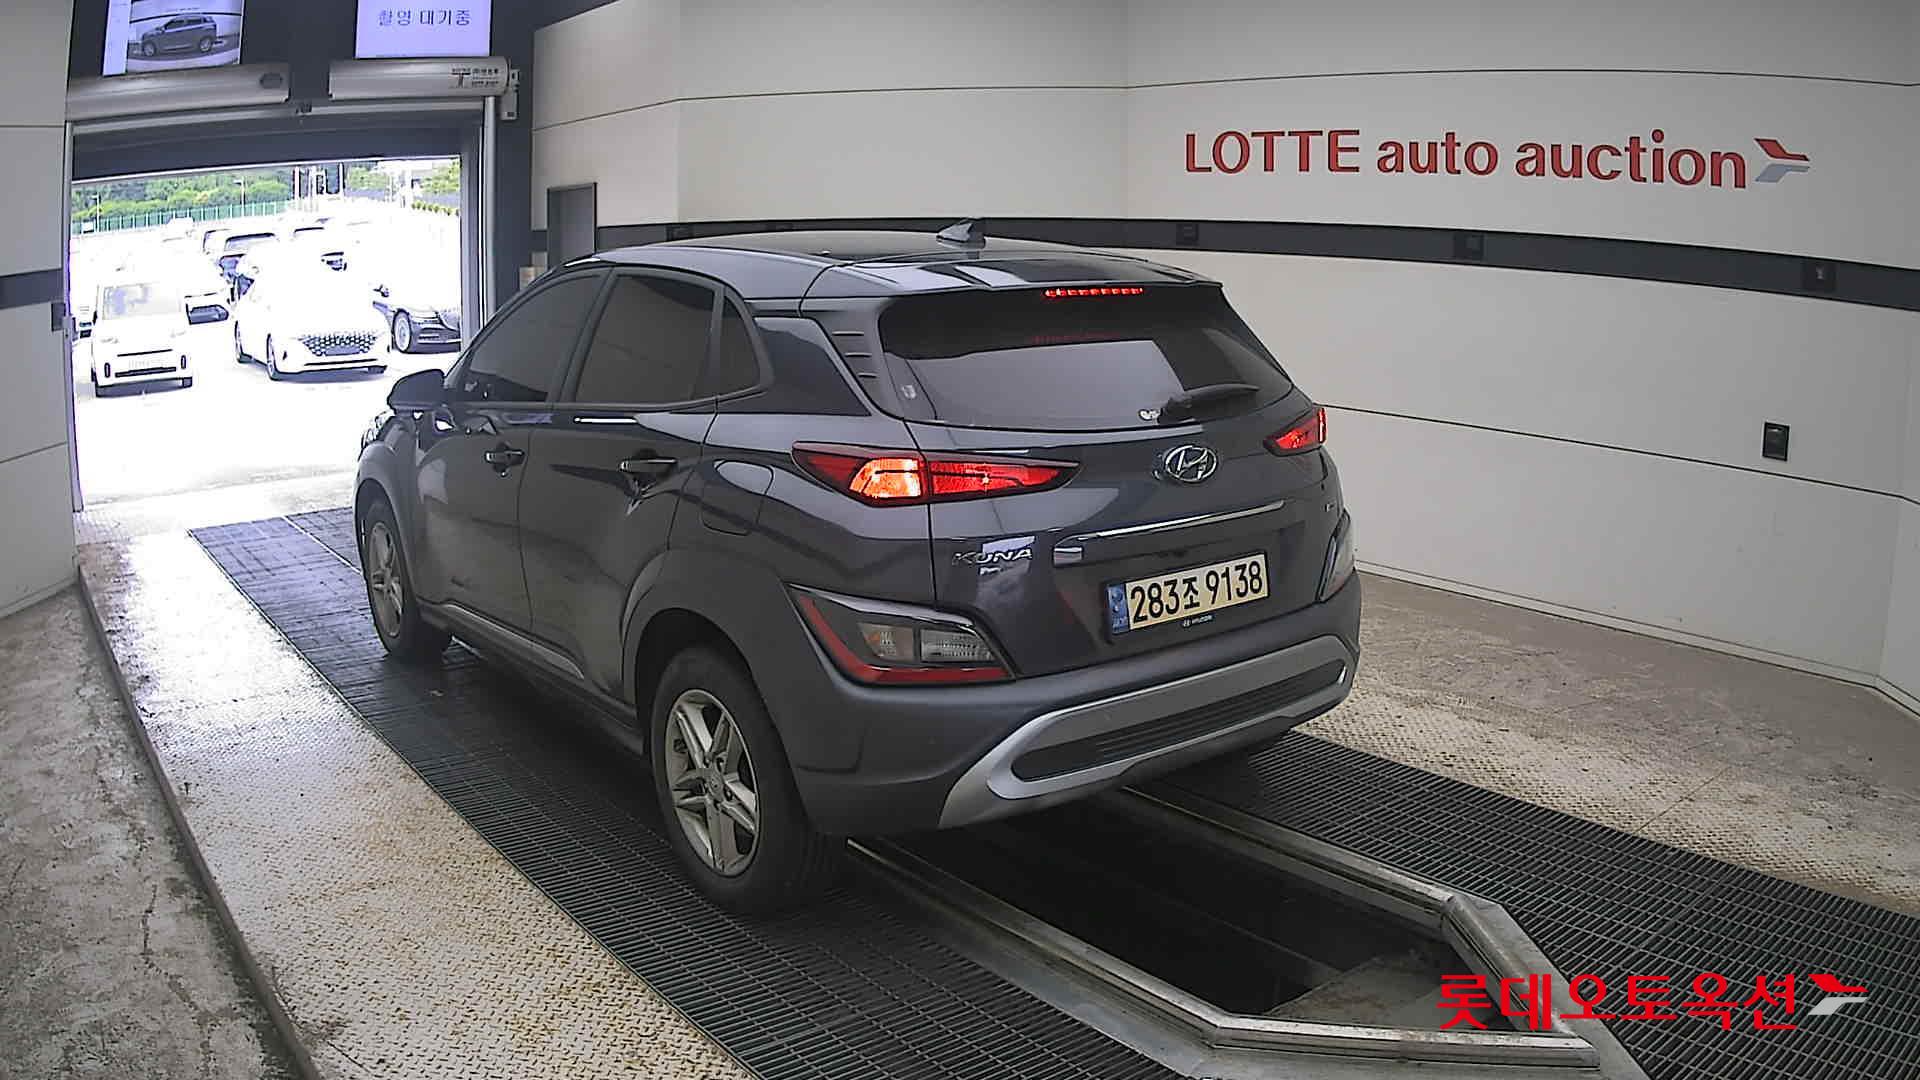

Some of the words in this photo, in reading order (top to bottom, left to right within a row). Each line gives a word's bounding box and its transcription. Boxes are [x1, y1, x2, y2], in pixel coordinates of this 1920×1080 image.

[420, 9, 470, 26] 대기중
[1185, 129, 1361, 174] LOTTE
[1377, 131, 1499, 177] auto
[1514, 128, 1747, 189] auction
[1130, 576, 1200, 624] 283조
[1205, 560, 1263, 605] 9138
